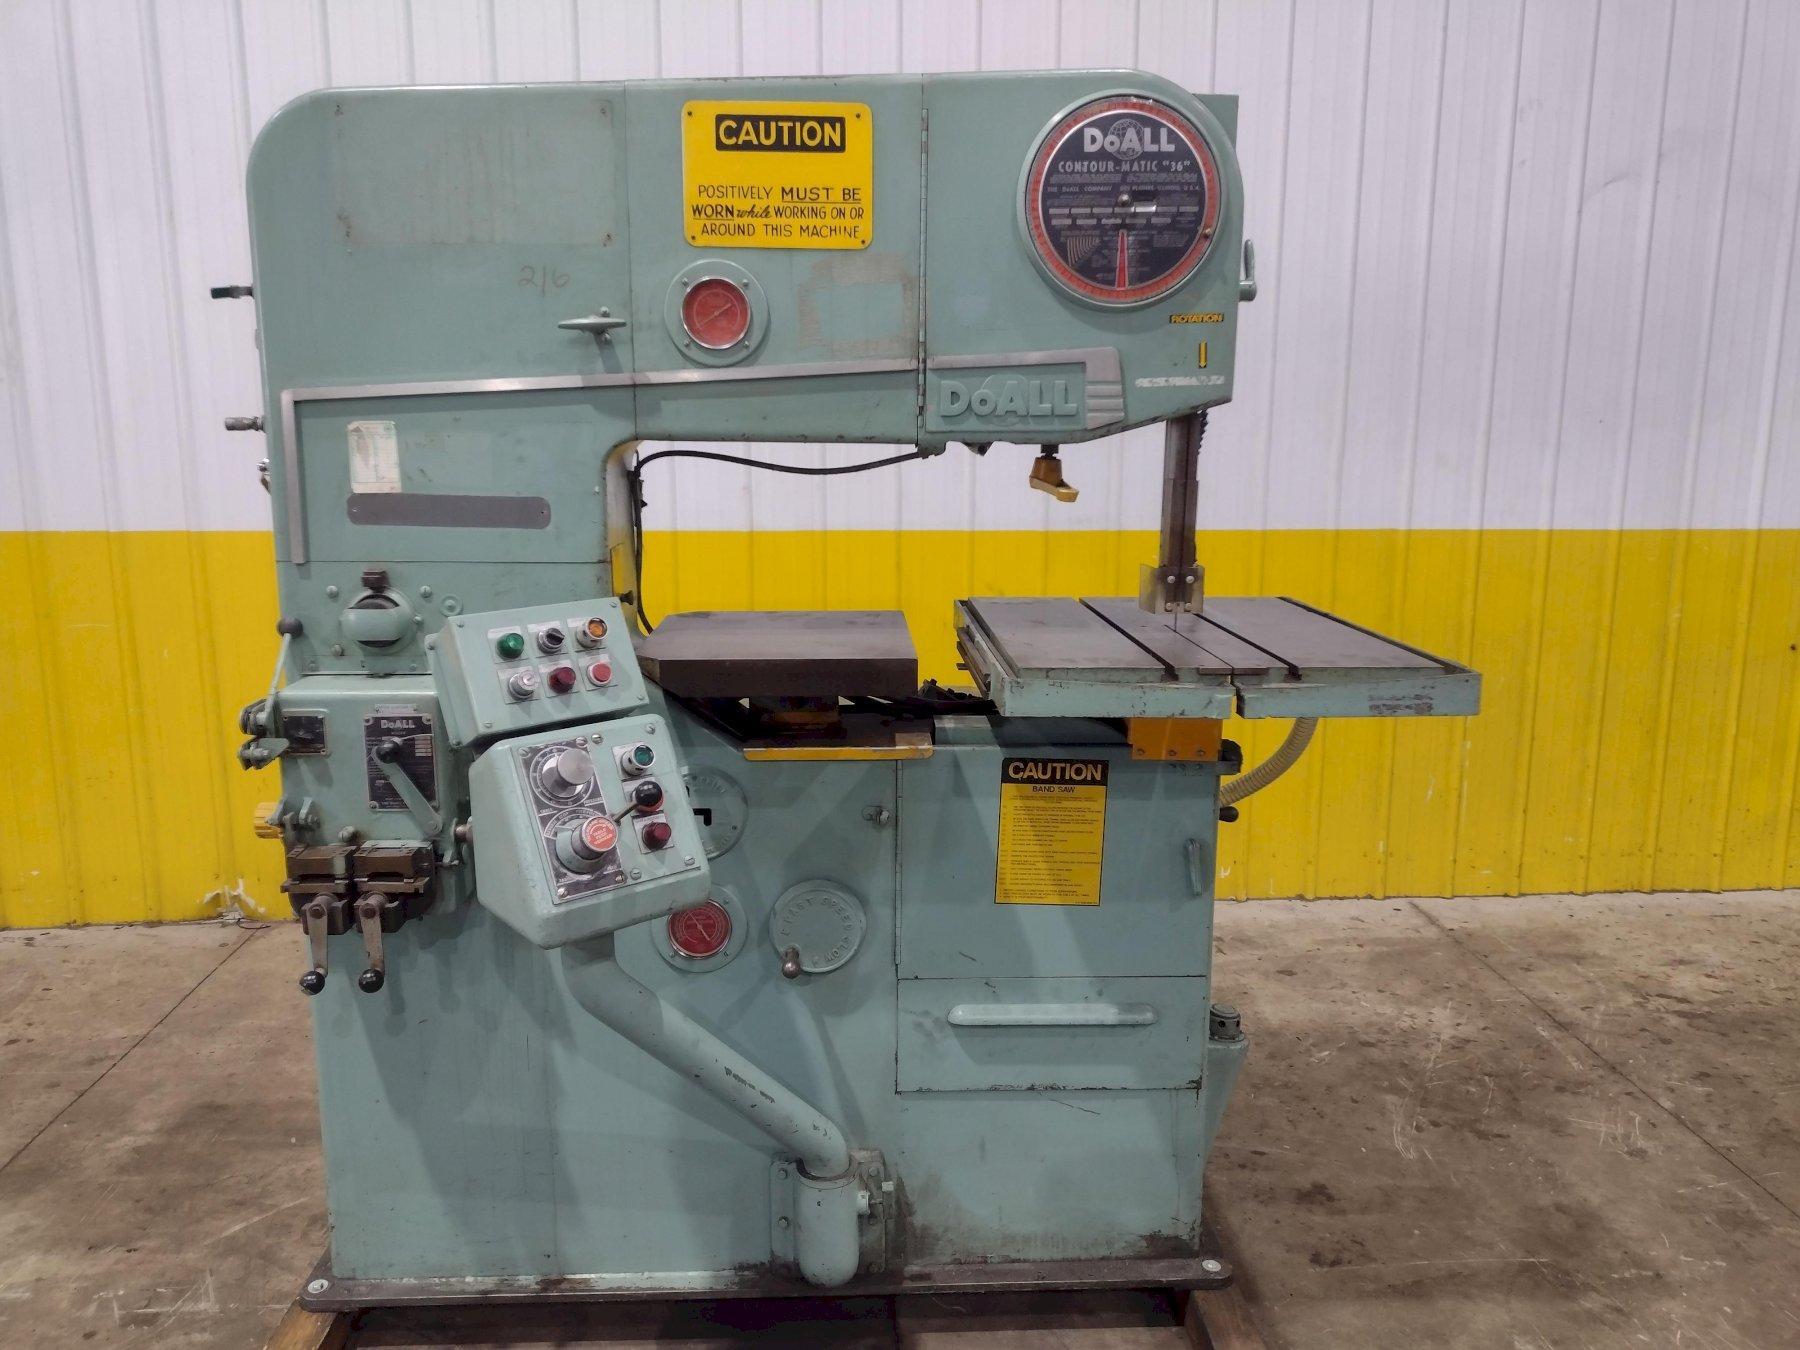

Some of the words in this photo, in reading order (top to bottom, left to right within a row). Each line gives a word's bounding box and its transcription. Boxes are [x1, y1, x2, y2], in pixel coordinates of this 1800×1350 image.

[718, 120, 841, 147] CAUTION
[1083, 127, 1175, 153] DoALL
[1058, 160, 1157, 172] CONTOUR-MATIC
[697, 184, 773, 200] POSITIVELY
[781, 186, 834, 202] MUST
[842, 187, 862, 202] BE
[691, 203, 734, 219] WORN
[736, 204, 772, 219] while
[773, 205, 827, 220] WORKING
[830, 206, 847, 220] ON
[849, 206, 864, 220] OR
[701, 223, 756, 237] AROUND
[763, 224, 793, 238] THIS
[800, 225, 861, 239] MACHINE
[1170, 313, 1223, 323] ROTATION
[940, 379, 1079, 417] DoALL
[380, 719, 416, 729] DoALL
[1008, 761, 1102, 781] CAUTION
